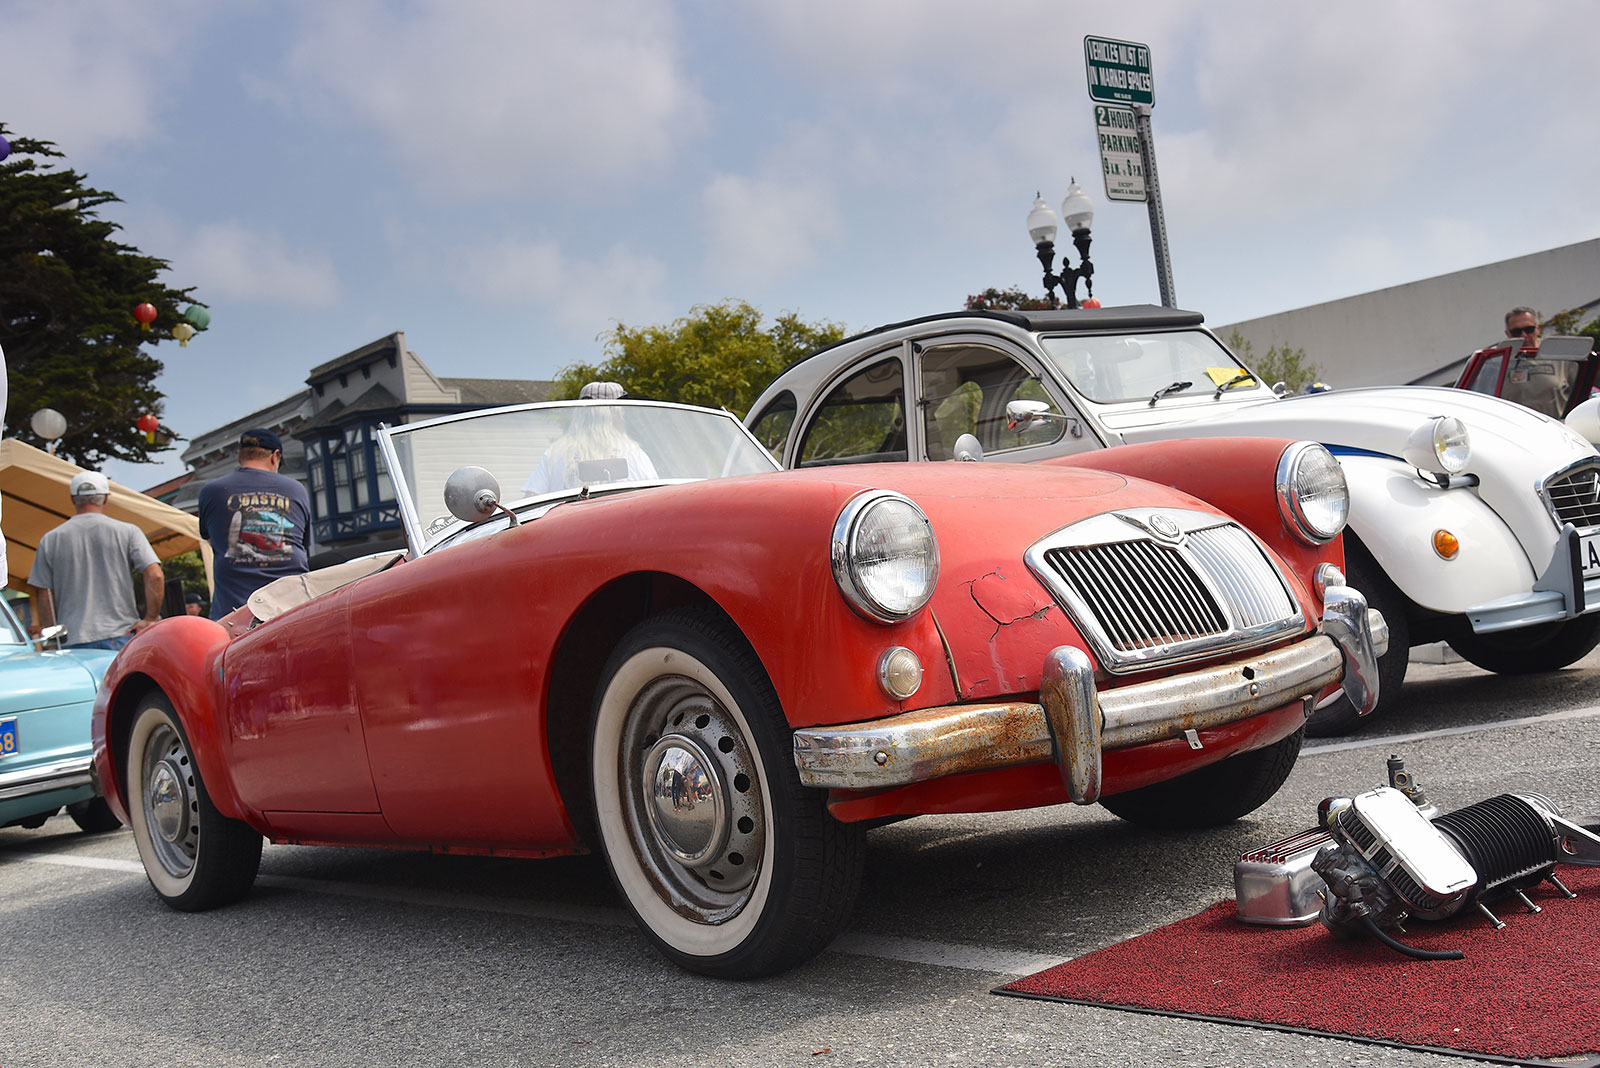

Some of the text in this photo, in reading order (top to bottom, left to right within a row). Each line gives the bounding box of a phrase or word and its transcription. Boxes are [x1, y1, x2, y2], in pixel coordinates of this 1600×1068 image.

[1088, 40, 1148, 68] VEHICLES MUST FIT
[1089, 65, 1151, 92] IN MARKED SPACES
[1097, 106, 1135, 130] 2 HOUR
[1100, 133, 1140, 154] PARKING
